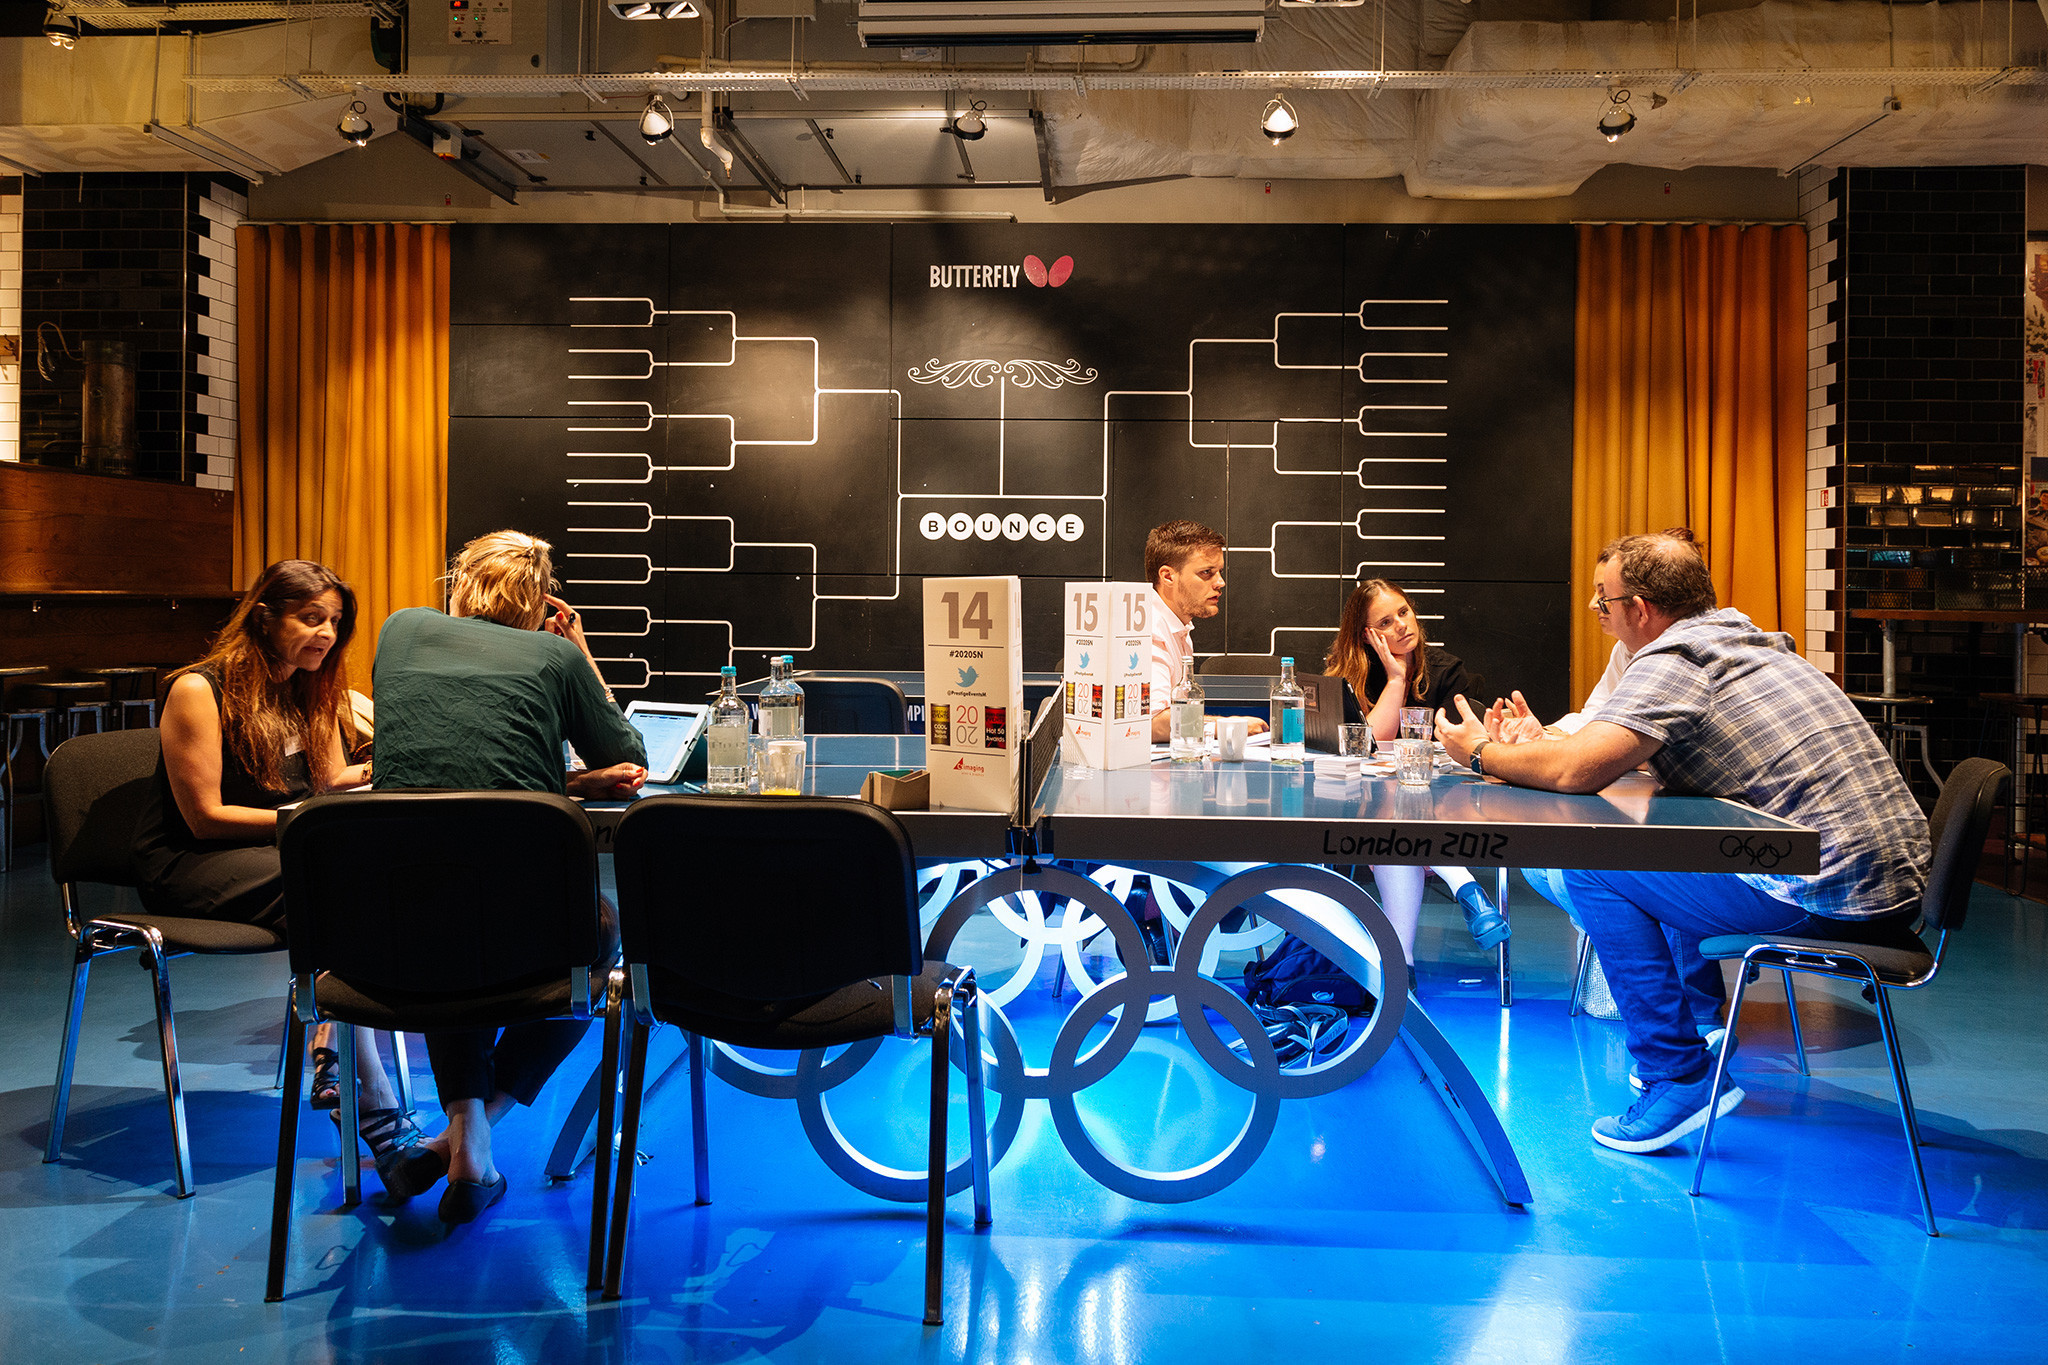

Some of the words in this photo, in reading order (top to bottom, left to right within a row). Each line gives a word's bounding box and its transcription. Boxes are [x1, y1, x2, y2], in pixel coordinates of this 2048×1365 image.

[929, 265, 1021, 288] BUTTERFLY
[926, 518, 1077, 535] BOUNCE
[941, 592, 993, 639] 14
[1073, 593, 1098, 632] 15
[1123, 593, 1146, 632] 15
[949, 650, 984, 659] #2020SN
[1077, 682, 1090, 699] 20
[1127, 683, 1139, 699] 20
[956, 705, 979, 725] 20
[1323, 829, 1432, 857] London
[1440, 832, 1509, 859] 2012
